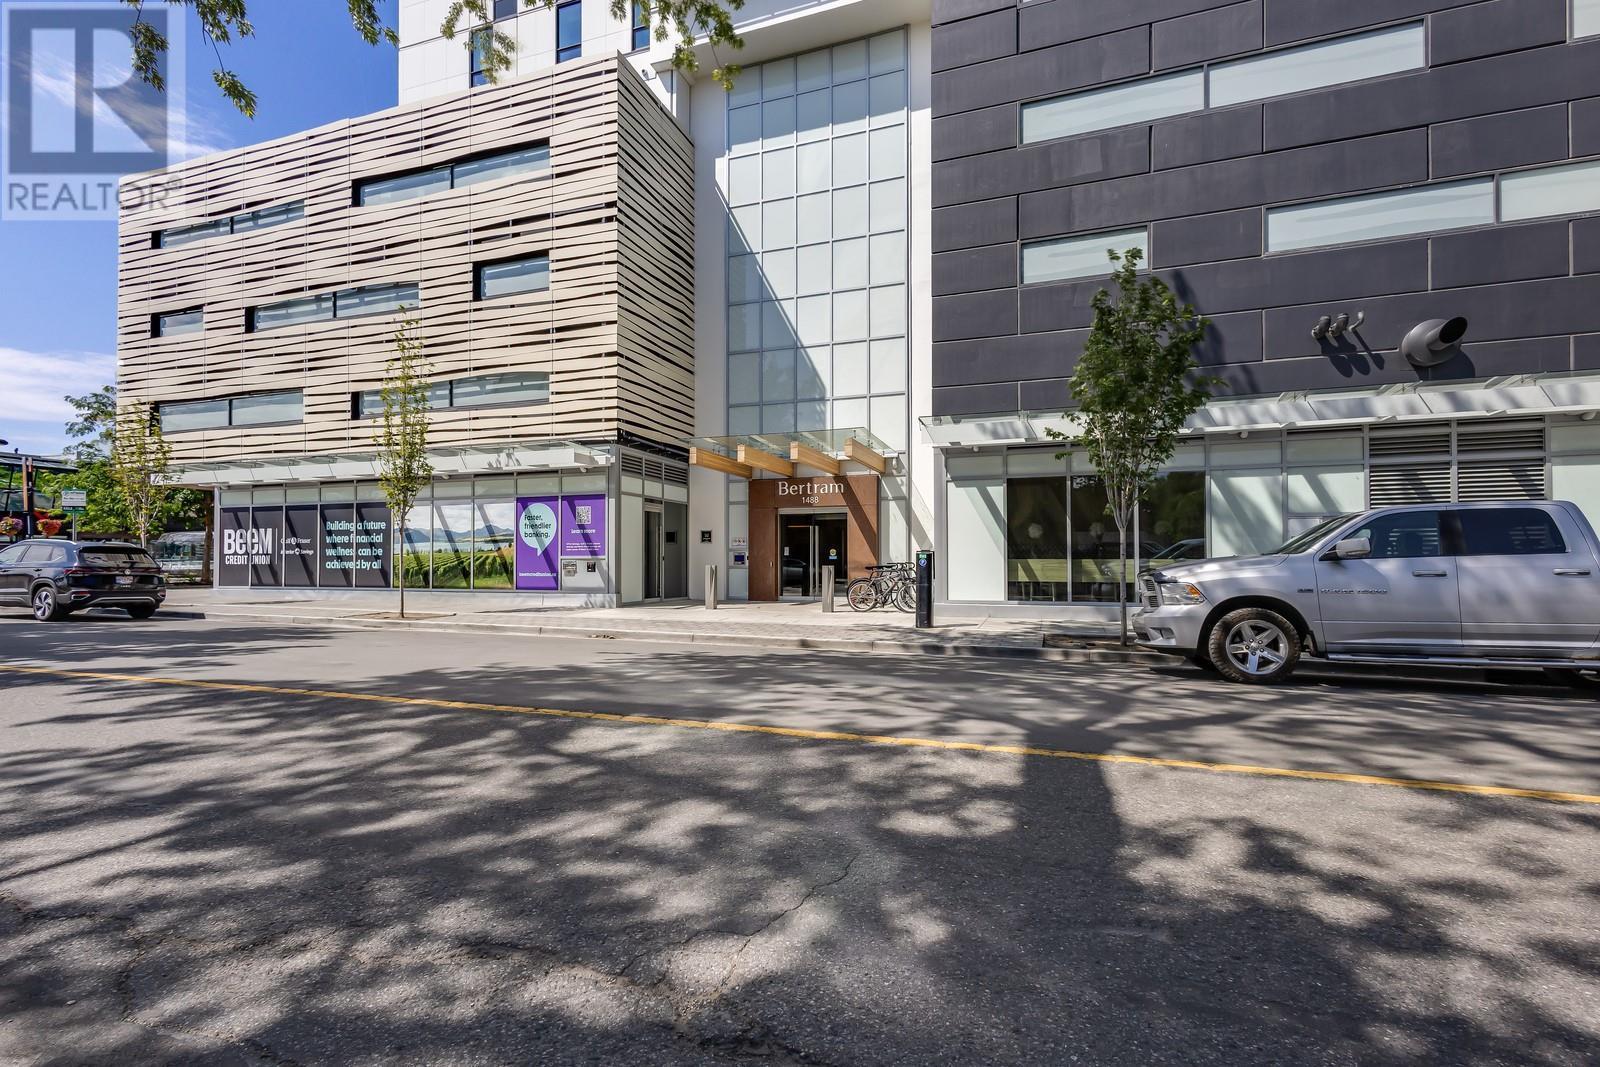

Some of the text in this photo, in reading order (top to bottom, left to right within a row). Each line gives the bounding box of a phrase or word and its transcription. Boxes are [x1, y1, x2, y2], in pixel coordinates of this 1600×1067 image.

[778, 481, 844, 496] Bertram
[801, 496, 820, 505] 1488
[326, 520, 355, 532] Building
[363, 520, 386, 530] future
[524, 522, 552, 530] friendlier
[326, 533, 349, 543] where
[524, 531, 551, 539] banking.
[326, 546, 383, 556] wellnes can be
[225, 555, 248, 565] CREDIT
[326, 559, 382, 570] achieved by all
